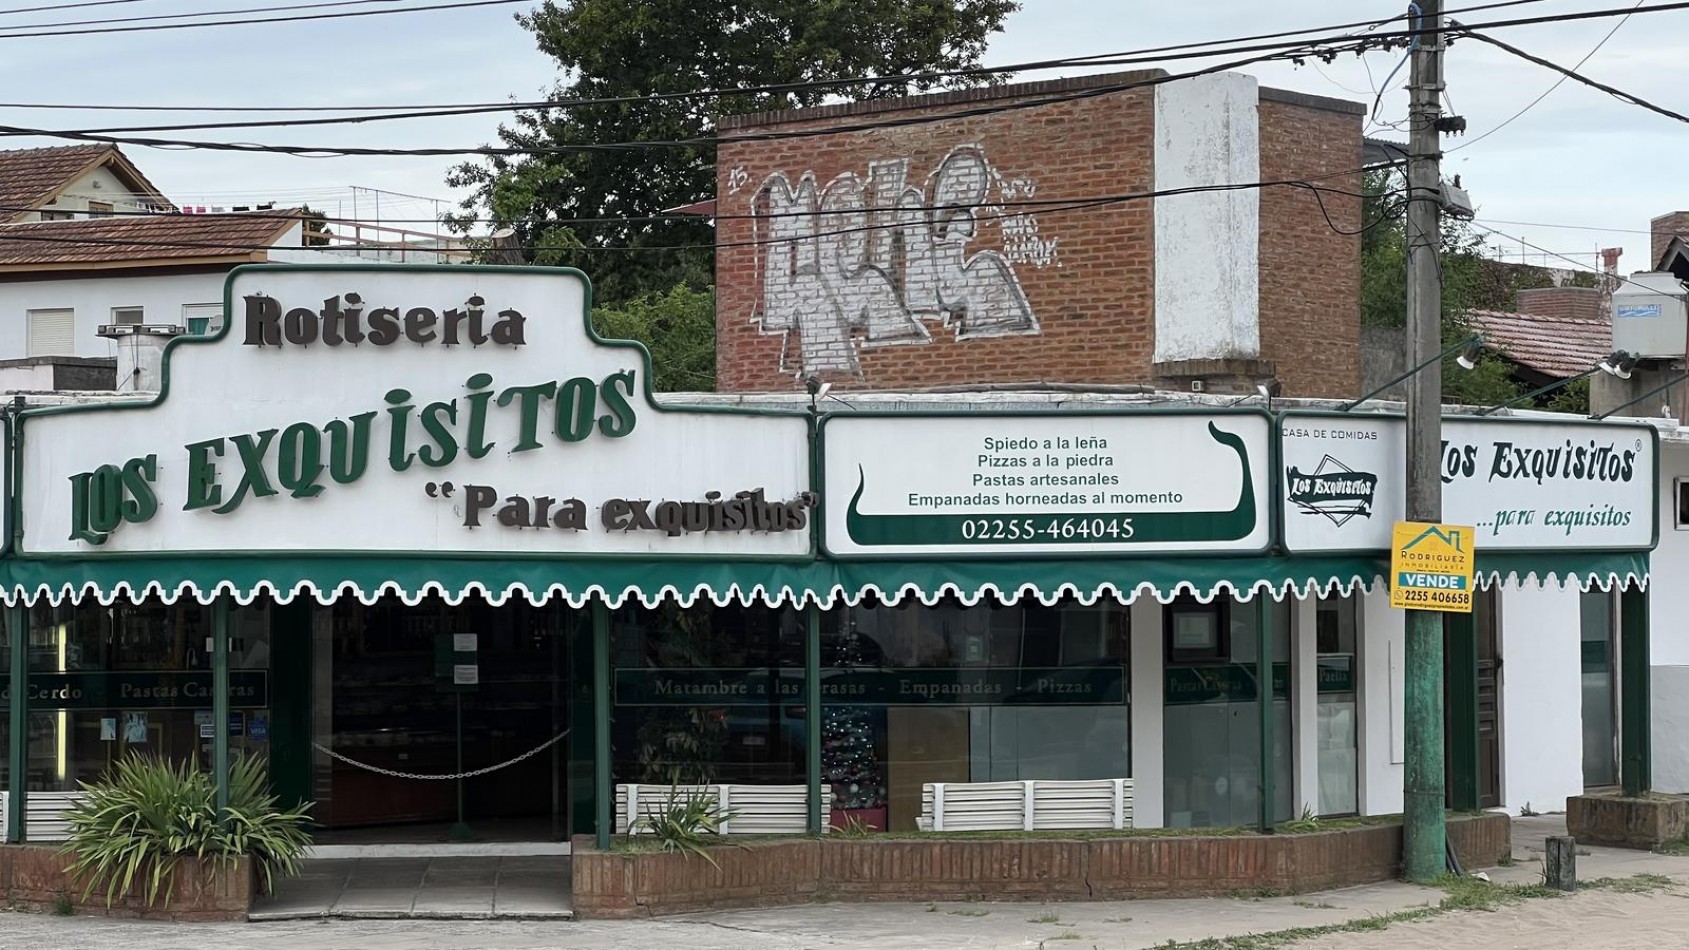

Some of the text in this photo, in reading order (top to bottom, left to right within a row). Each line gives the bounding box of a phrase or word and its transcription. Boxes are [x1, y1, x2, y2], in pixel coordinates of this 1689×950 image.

[243, 292, 527, 348] Rotiseria
[1282, 428, 1378, 440] CASA DE COMIDAS
[984, 436, 1107, 451] Spiedo a la leña
[978, 454, 1114, 470] Pizzas a la piedra
[973, 473, 1119, 487] Pastas artesanales
[68, 453, 157, 545] LOS
[908, 491, 1183, 509] Empanadas horneadas al momento
[1544, 503, 1632, 536] exquisitos
[962, 518, 1135, 540] 02255-464045
[1405, 573, 1459, 589] VENDE
[1405, 590, 1470, 604] 2255 406658
[120, 682, 254, 698] Pastas Casras
[655, 679, 748, 695] Matambre
[757, 683, 765, 694] a
[775, 679, 799, 694] las
[819, 682, 866, 695] rasas
[899, 679, 1001, 698] Empanadas
[1037, 678, 1092, 694] Pizzas
